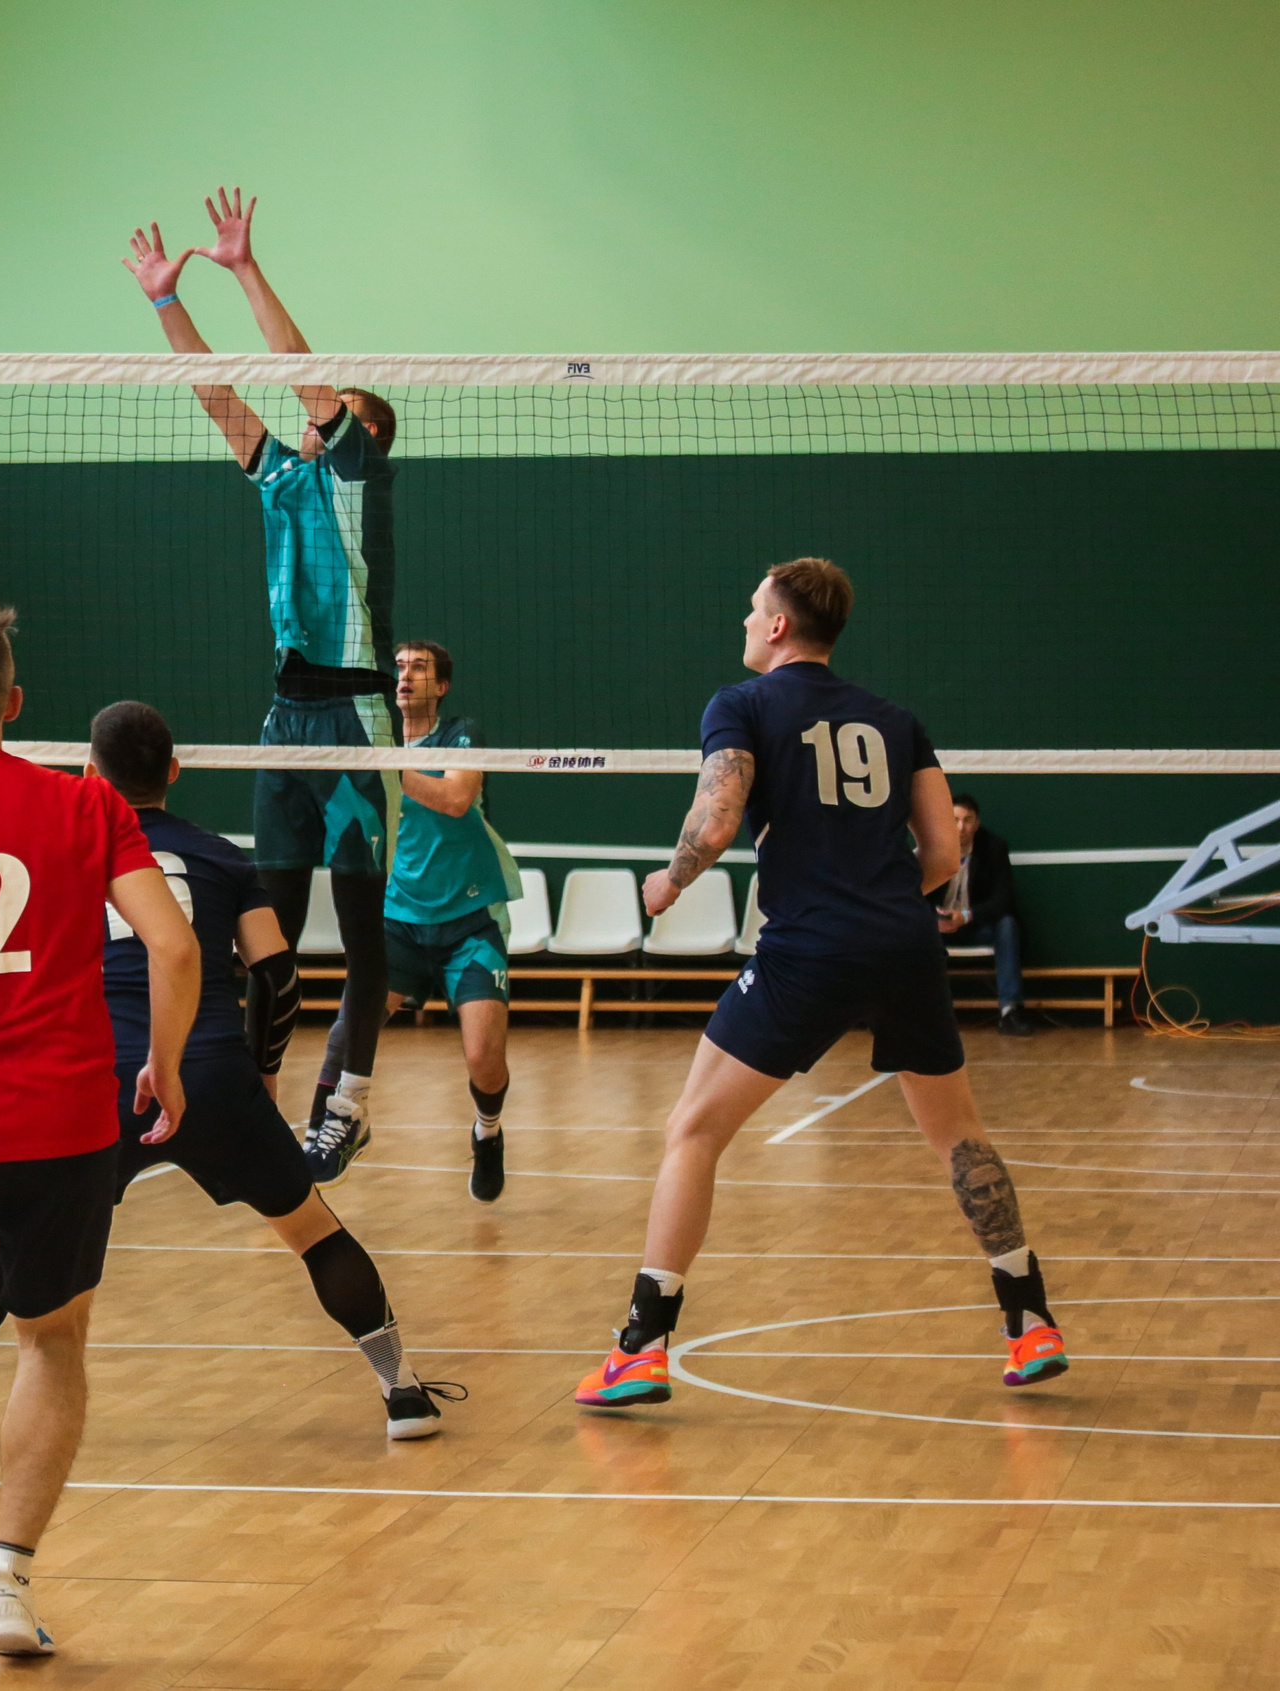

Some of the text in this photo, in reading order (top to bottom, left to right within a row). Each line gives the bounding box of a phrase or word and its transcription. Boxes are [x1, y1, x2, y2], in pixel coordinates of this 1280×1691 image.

[567, 362, 591, 374] FIVB
[548, 756, 606, 769] 金陵体育
[801, 720, 890, 808] 19
[371, 836, 379, 860] 7
[491, 969, 506, 990] 12
